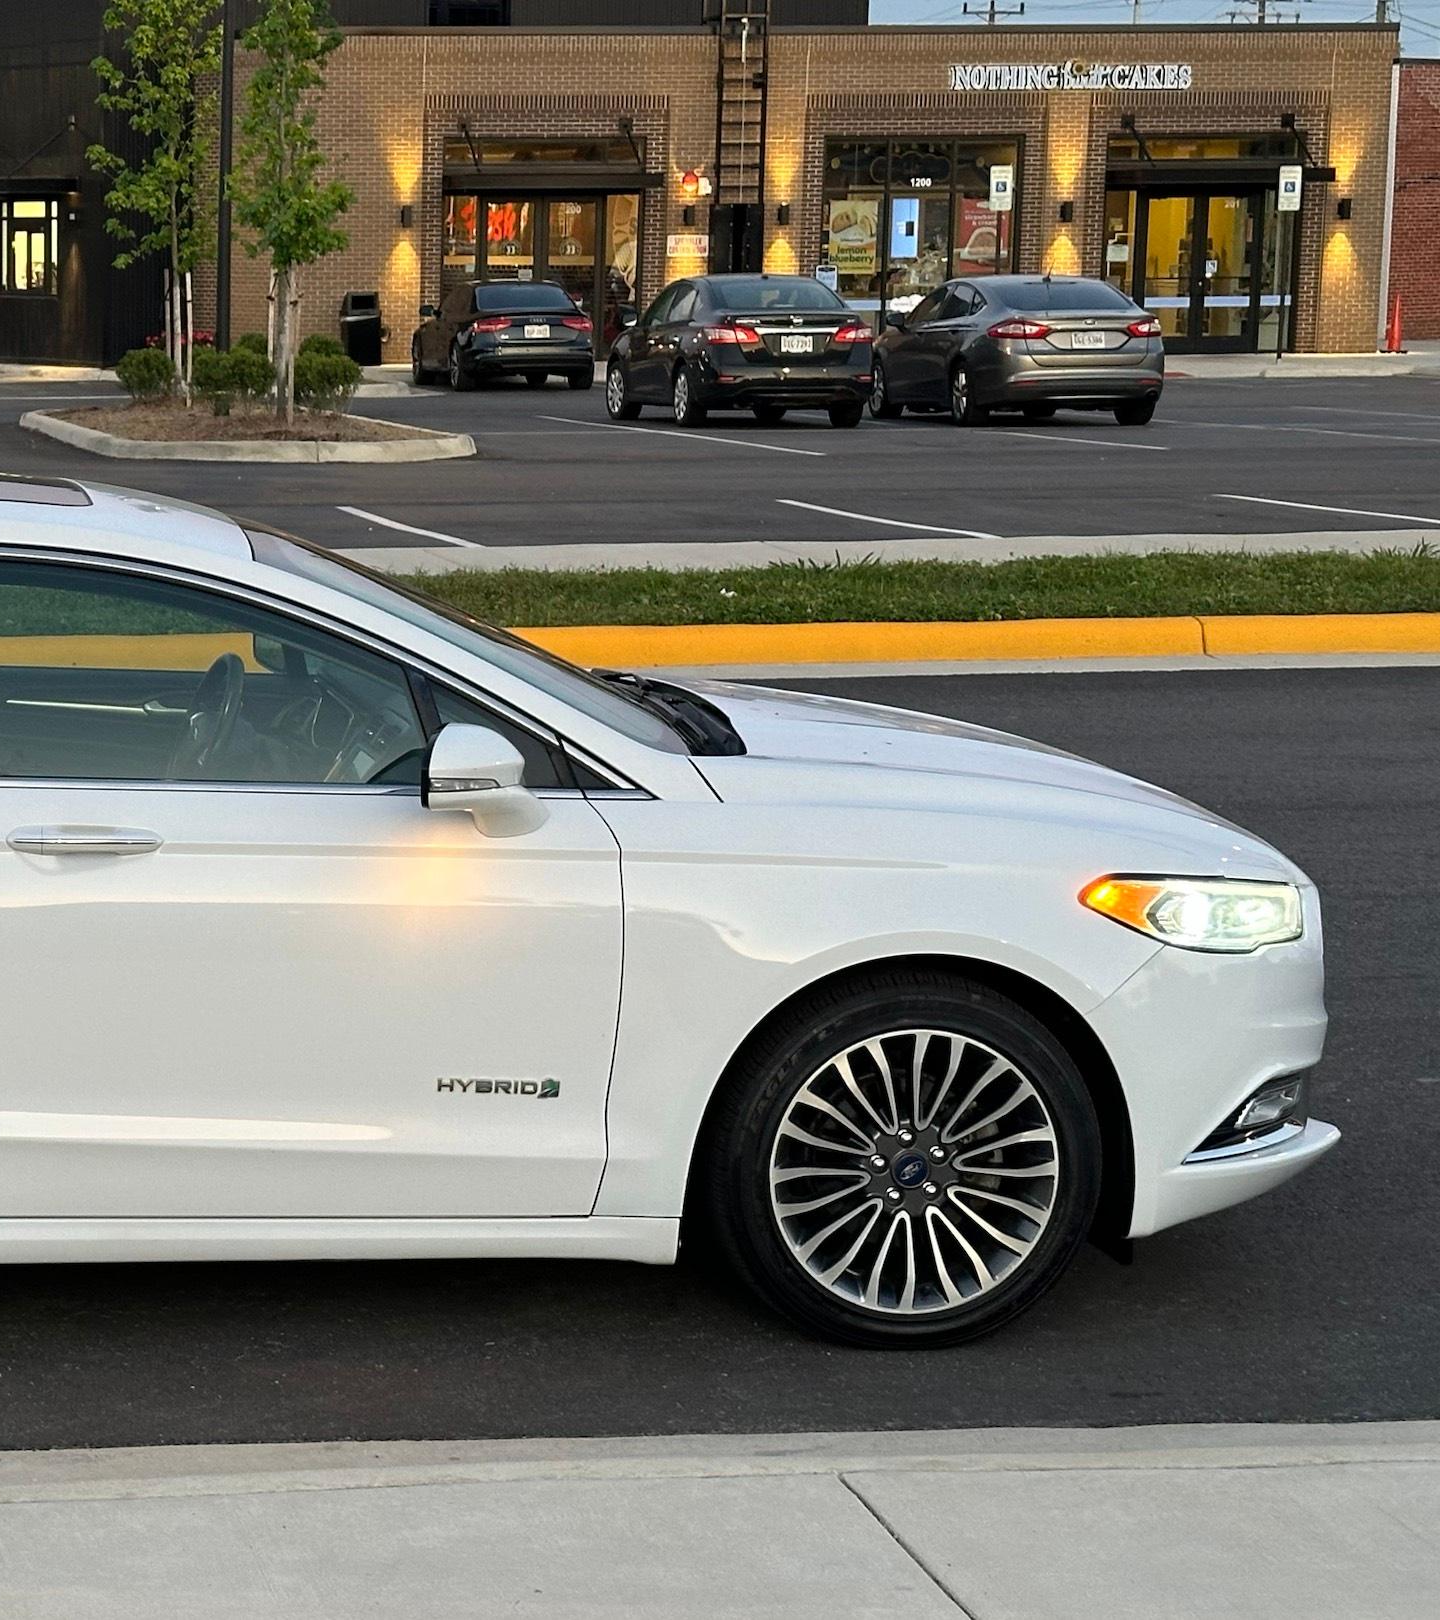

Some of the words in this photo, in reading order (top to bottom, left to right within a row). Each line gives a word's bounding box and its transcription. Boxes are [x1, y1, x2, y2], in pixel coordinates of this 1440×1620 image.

[953, 63, 1059, 91] NOTHING
[1111, 64, 1193, 91] CAKES
[910, 177, 933, 188] 1200
[837, 245, 867, 254] lemon
[829, 254, 875, 264] blueberry
[437, 1078, 538, 1095] HYBRID
